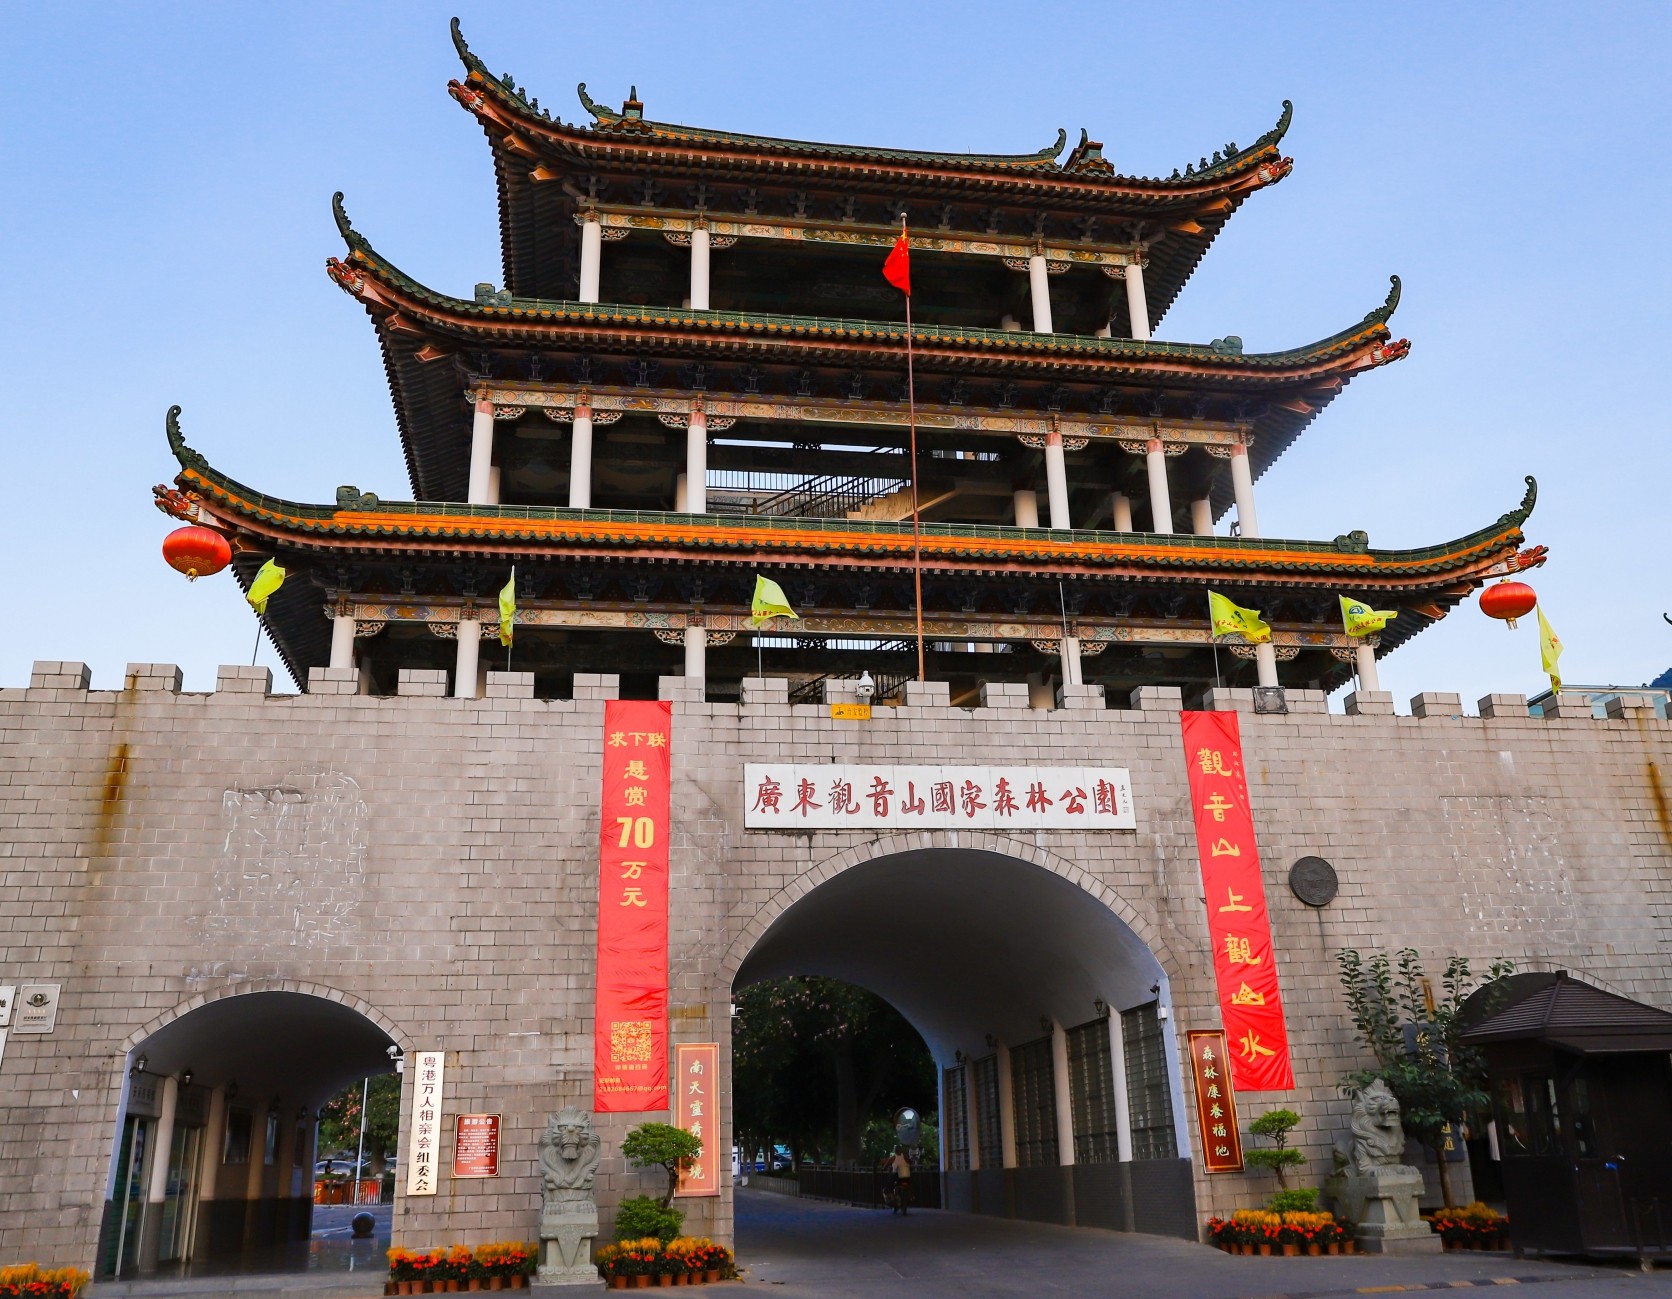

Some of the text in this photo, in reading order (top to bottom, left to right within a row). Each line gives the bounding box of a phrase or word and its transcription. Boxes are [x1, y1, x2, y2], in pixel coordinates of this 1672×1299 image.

[608, 731, 667, 748] 求下联
[751, 774, 1118, 818] 廣東觀音山國家森林公園
[1197, 748, 1275, 1062] 觀音山上觀山水
[416, 1056, 437, 1191] 粤港万人相亲会组委会
